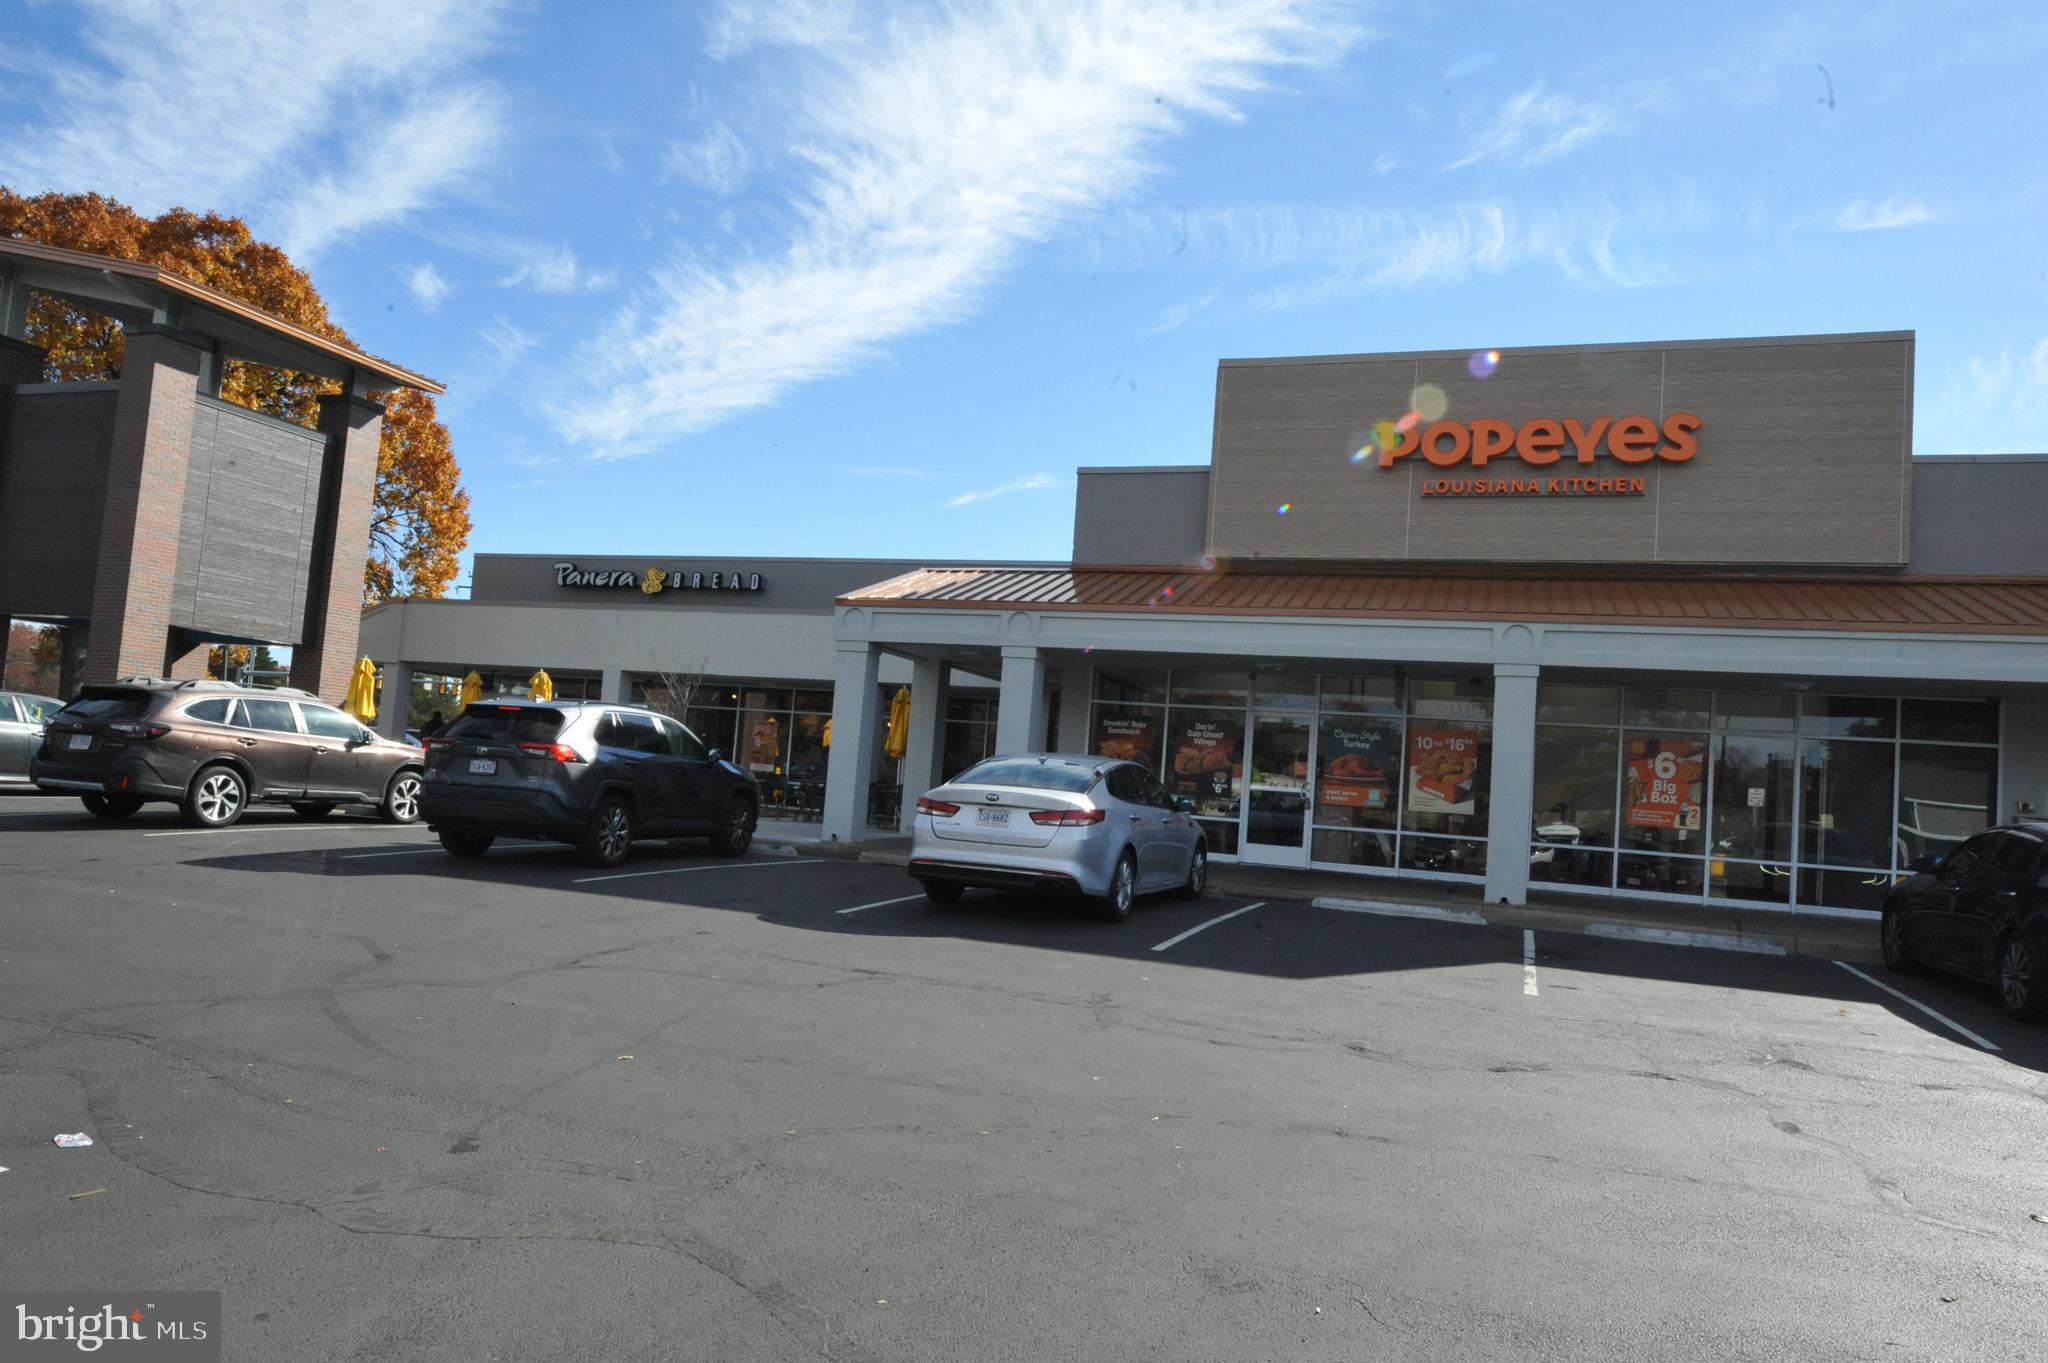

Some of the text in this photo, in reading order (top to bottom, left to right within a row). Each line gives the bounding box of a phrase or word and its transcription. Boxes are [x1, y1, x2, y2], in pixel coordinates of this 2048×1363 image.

[1422, 477, 1645, 494] LOUISIANA KITCHEN
[554, 562, 760, 590] Panera BREAD
[1108, 726, 1141, 736] Sandwich
[1202, 730, 1224, 739] Ghost
[1194, 737, 1217, 747] Wings
[1343, 739, 1371, 749] Turkey
[1416, 736, 1433, 749] 10
[1653, 779, 1677, 794] Big
[1651, 791, 1677, 804] Box
